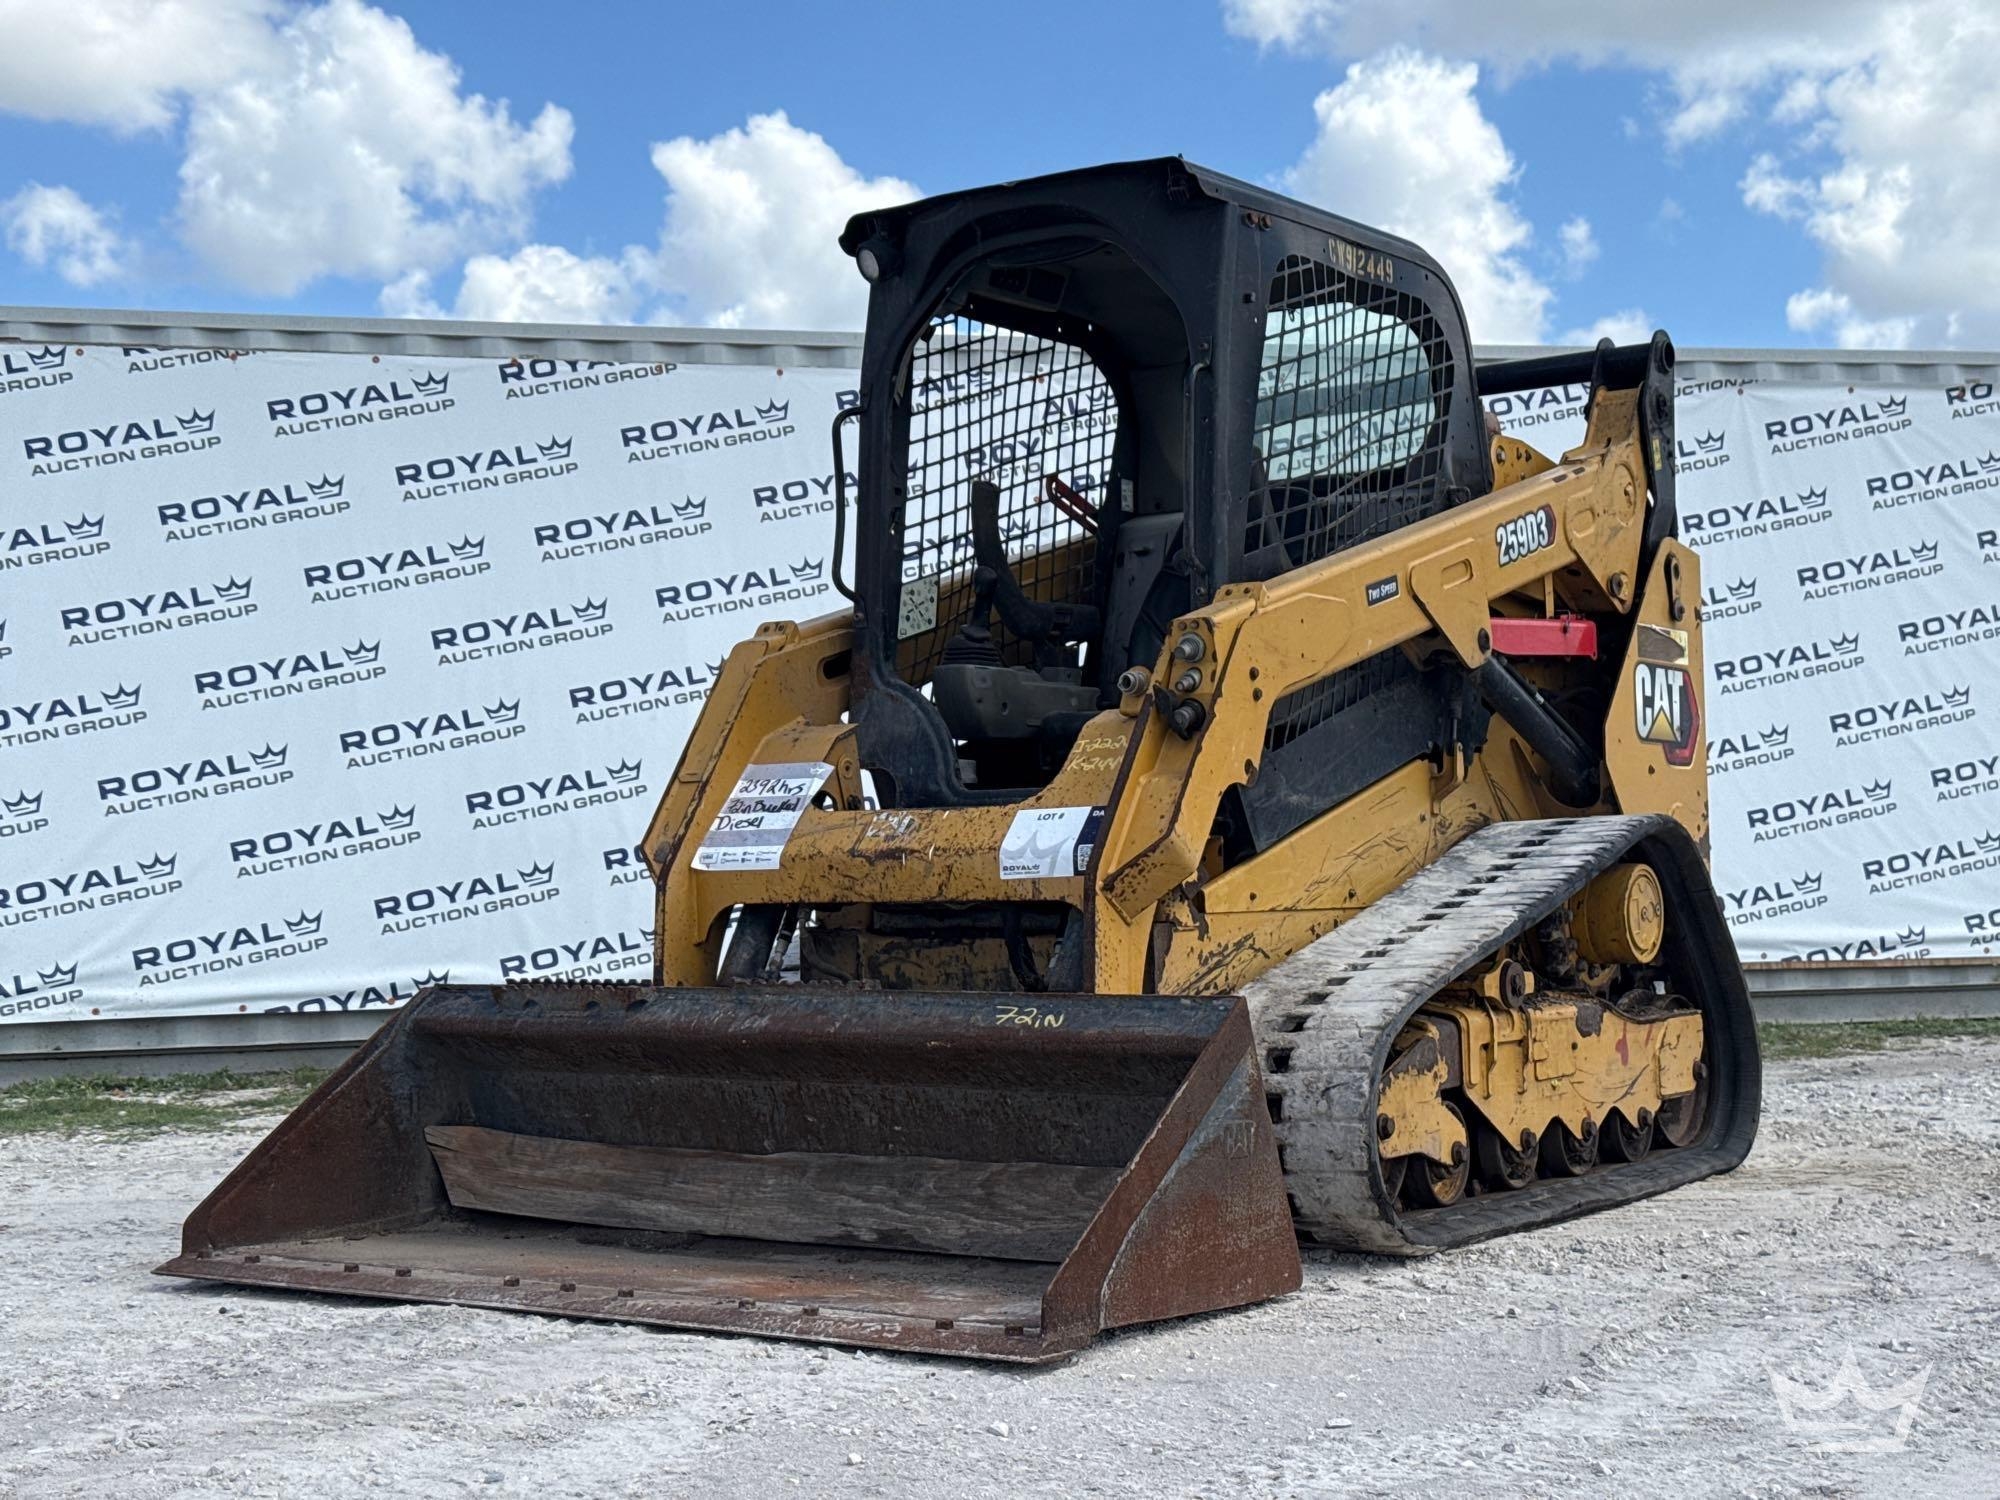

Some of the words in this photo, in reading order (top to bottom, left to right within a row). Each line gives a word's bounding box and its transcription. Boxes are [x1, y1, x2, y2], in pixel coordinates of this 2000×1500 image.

[128, 349, 231, 374] AUCTION
[506, 374, 600, 400] AUCTION
[604, 363, 677, 384] GROUP
[266, 381, 414, 421] ROYAL
[1489, 385, 1582, 416] OYAL
[1674, 379, 1738, 398] UCTION
[274, 411, 374, 438] AUCTION
[378, 398, 455, 420] GROUP
[620, 409, 757, 447] ROYAL
[1765, 404, 1879, 441] ROYAL
[1771, 430, 1849, 455] AUCTION
[1852, 418, 1912, 439] GROUP
[23, 419, 178, 460] ROYAL
[32, 449, 136, 477] AUCTION
[140, 436, 221, 459] GROUP
[628, 438, 720, 463] AUCTION
[723, 425, 795, 446] GROUP
[395, 446, 538, 486] ROYAL
[402, 475, 499, 502] AUCTION
[503, 462, 578, 484] GROUP
[1866, 460, 1979, 497] ROYAL
[157, 484, 308, 526] ROYAL
[1873, 486, 1948, 511] AUCTION
[1951, 476, 1999, 495] GROU
[166, 515, 267, 543] AUCTION
[271, 501, 351, 524] GROUP
[534, 506, 673, 546] ROYAL
[1682, 496, 1799, 534] ROYAL
[1689, 523, 1767, 548] AUCTION
[1770, 510, 1832, 531] GROUP
[27, 542, 111, 565] GROUP
[541, 535, 635, 563] AUCTION
[639, 522, 712, 544] GROUP
[1496, 509, 1549, 566] 259D3
[303, 546, 450, 588] ROYAL
[311, 576, 410, 604] AUCTION
[414, 562, 491, 585] GROUP
[1797, 549, 1912, 587] ROYAL
[1803, 576, 1881, 601] AUCTION
[1884, 563, 1944, 584] GROUP
[655, 568, 791, 608] ROYAL
[663, 597, 754, 624] AUCTION
[758, 583, 829, 606] GROUP
[60, 587, 215, 630] ROYAL
[68, 618, 173, 647] AUCTION
[177, 603, 258, 627] GROUP
[430, 608, 573, 650] ROYAL
[438, 638, 534, 666] AUCTION
[538, 623, 613, 647] GROUP
[1904, 631, 1980, 656] AUCTION
[194, 650, 344, 694] ROYAL
[1714, 642, 1832, 681] ROYAL
[1721, 669, 1800, 695] AUCTION
[1802, 656, 1864, 678] GROUP
[202, 681, 303, 711] AUCTION
[308, 666, 386, 690] GROUP
[569, 666, 707, 708] ROYAL
[1635, 663, 1684, 742] CAT
[0, 727, 60, 748] TION
[64, 711, 147, 736] GROUP
[576, 696, 670, 724] AUCTION
[1829, 695, 1943, 733] ROYAL
[1836, 722, 1913, 748] AUCTION
[1916, 708, 1976, 730] GROUP
[339, 709, 485, 753] ROYAL
[346, 740, 445, 770] AUCTION
[449, 725, 526, 749] GROUP
[97, 755, 251, 800] ROYAL
[1732, 748, 1794, 770] GROUP
[1930, 755, 1999, 788] ROY
[104, 786, 209, 817] AUCTION
[213, 770, 294, 795] GROUP
[465, 770, 608, 814] ROYAL
[472, 800, 569, 830] AUCTION
[573, 785, 648, 809] GROUP
[1747, 789, 1864, 829] ROYAL
[1937, 779, 1999, 802] AUCTIO
[716, 815, 764, 831] Diesel
[1037, 813, 1058, 821] LOT
[1754, 816, 1833, 843] AUCTION
[1836, 802, 1897, 824] GROUP
[229, 816, 380, 862] ROYAL
[237, 848, 339, 879] AUCTION
[343, 831, 421, 856] GROUP
[1862, 840, 1977, 880] ROYAL
[1869, 868, 1946, 895] AUCTION
[1949, 855, 2000, 876] GROU
[0, 897, 95, 927] UCTION
[100, 880, 183, 906] GROUP
[373, 873, 519, 919] ROYAL
[381, 904, 479, 936] AUCTION
[483, 888, 560, 913] GROUP
[1765, 895, 1828, 918] GROUP
[132, 923, 286, 971] ROYAL
[139, 955, 243, 988] AUCTION
[248, 937, 328, 964] GROUP
[500, 932, 641, 978] ROYAL
[606, 952, 652, 972] GRO
[0, 989, 84, 1017] GROUP
